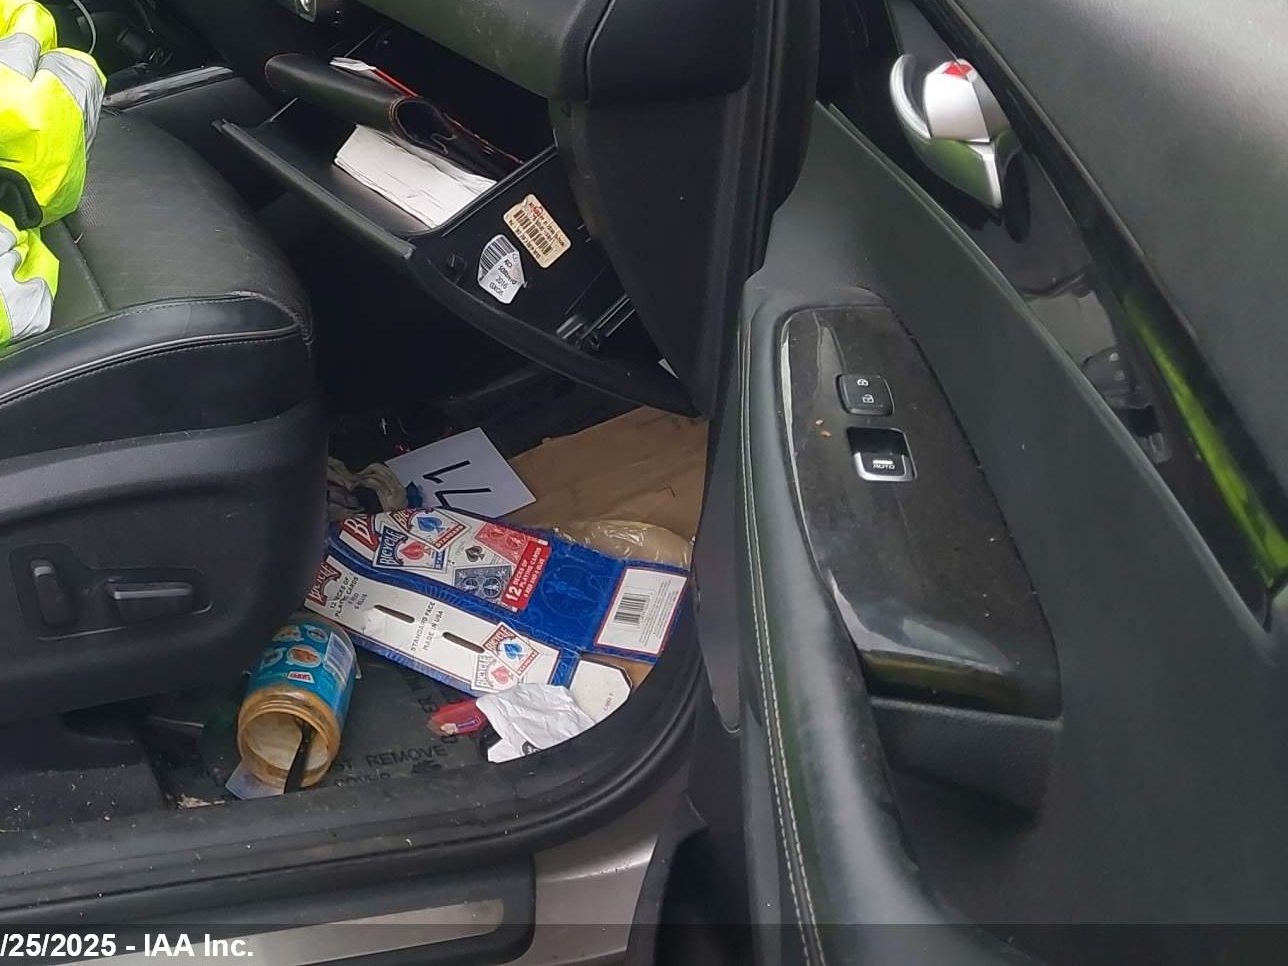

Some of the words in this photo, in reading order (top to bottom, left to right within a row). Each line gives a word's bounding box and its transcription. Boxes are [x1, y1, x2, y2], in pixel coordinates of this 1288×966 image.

[379, 529, 403, 565] BICYCLE
[519, 565, 533, 588] PLAYING
[530, 547, 542, 565] CARDS
[521, 559, 528, 568] OF
[343, 576, 350, 585] OF
[346, 576, 359, 594] CARDS
[513, 567, 525, 585] DECKS
[505, 586, 522, 601] 12
[425, 601, 436, 616] FACE
[434, 610, 444, 622] USA
[485, 626, 516, 652] BICYCLE
[366, 744, 447, 768] REMOVE
